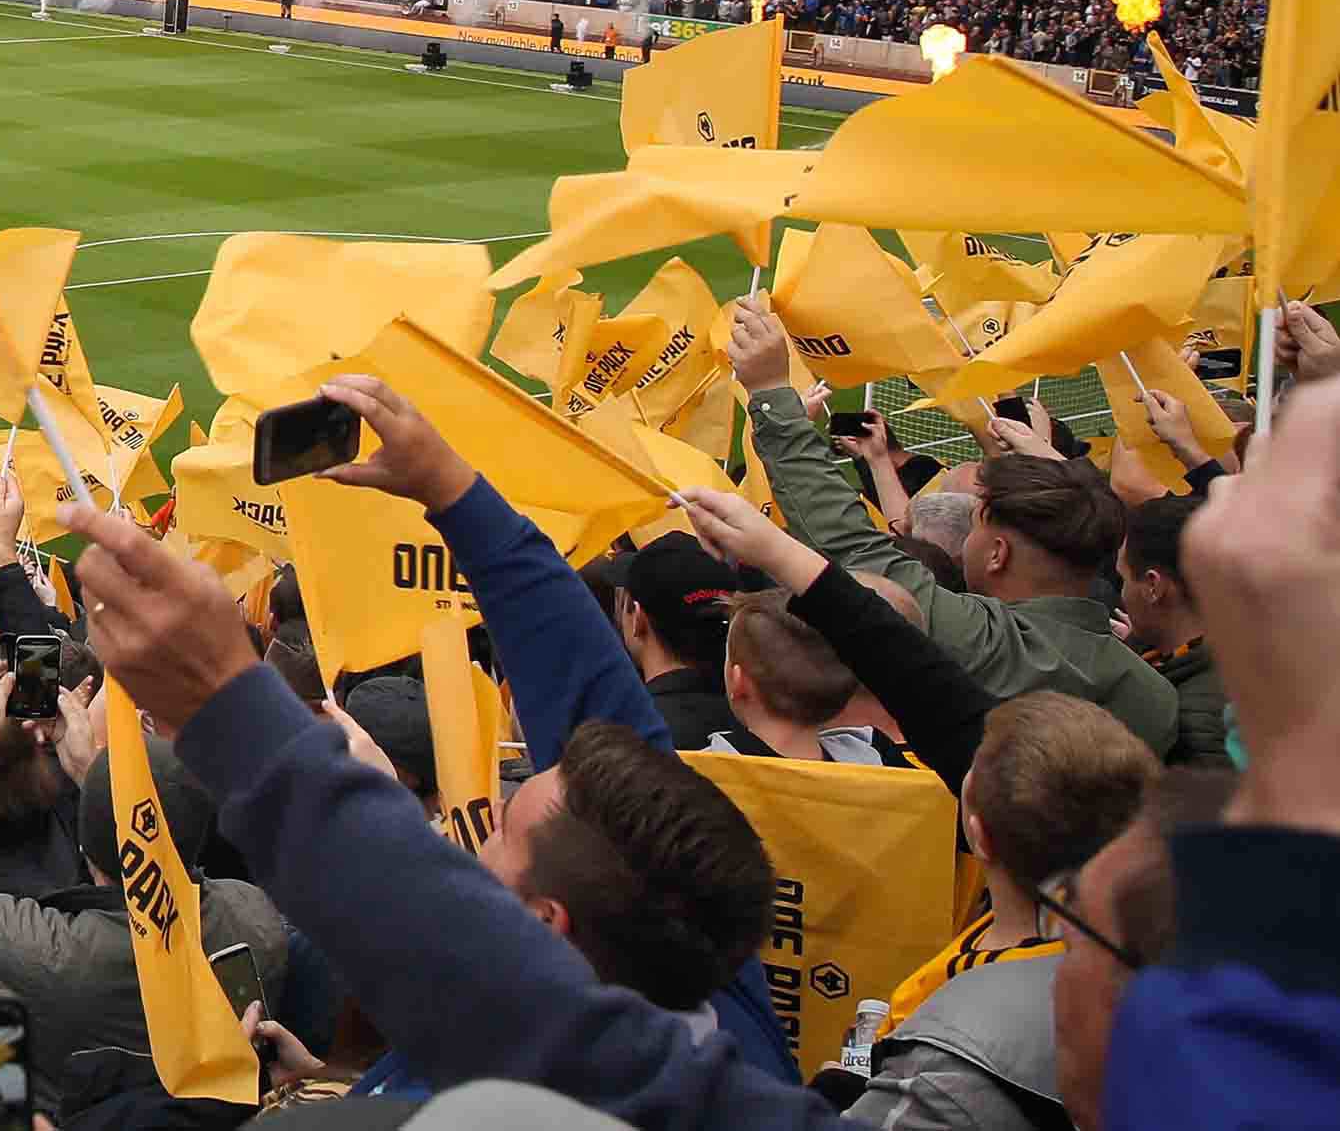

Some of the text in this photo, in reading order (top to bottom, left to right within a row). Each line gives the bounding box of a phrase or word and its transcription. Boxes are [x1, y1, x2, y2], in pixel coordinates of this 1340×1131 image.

[458, 30, 485, 44] Now
[486, 34, 536, 51] available
[649, 20, 708, 37] et365
[39, 312, 72, 367] PACK
[583, 340, 636, 396] ONE PACK
